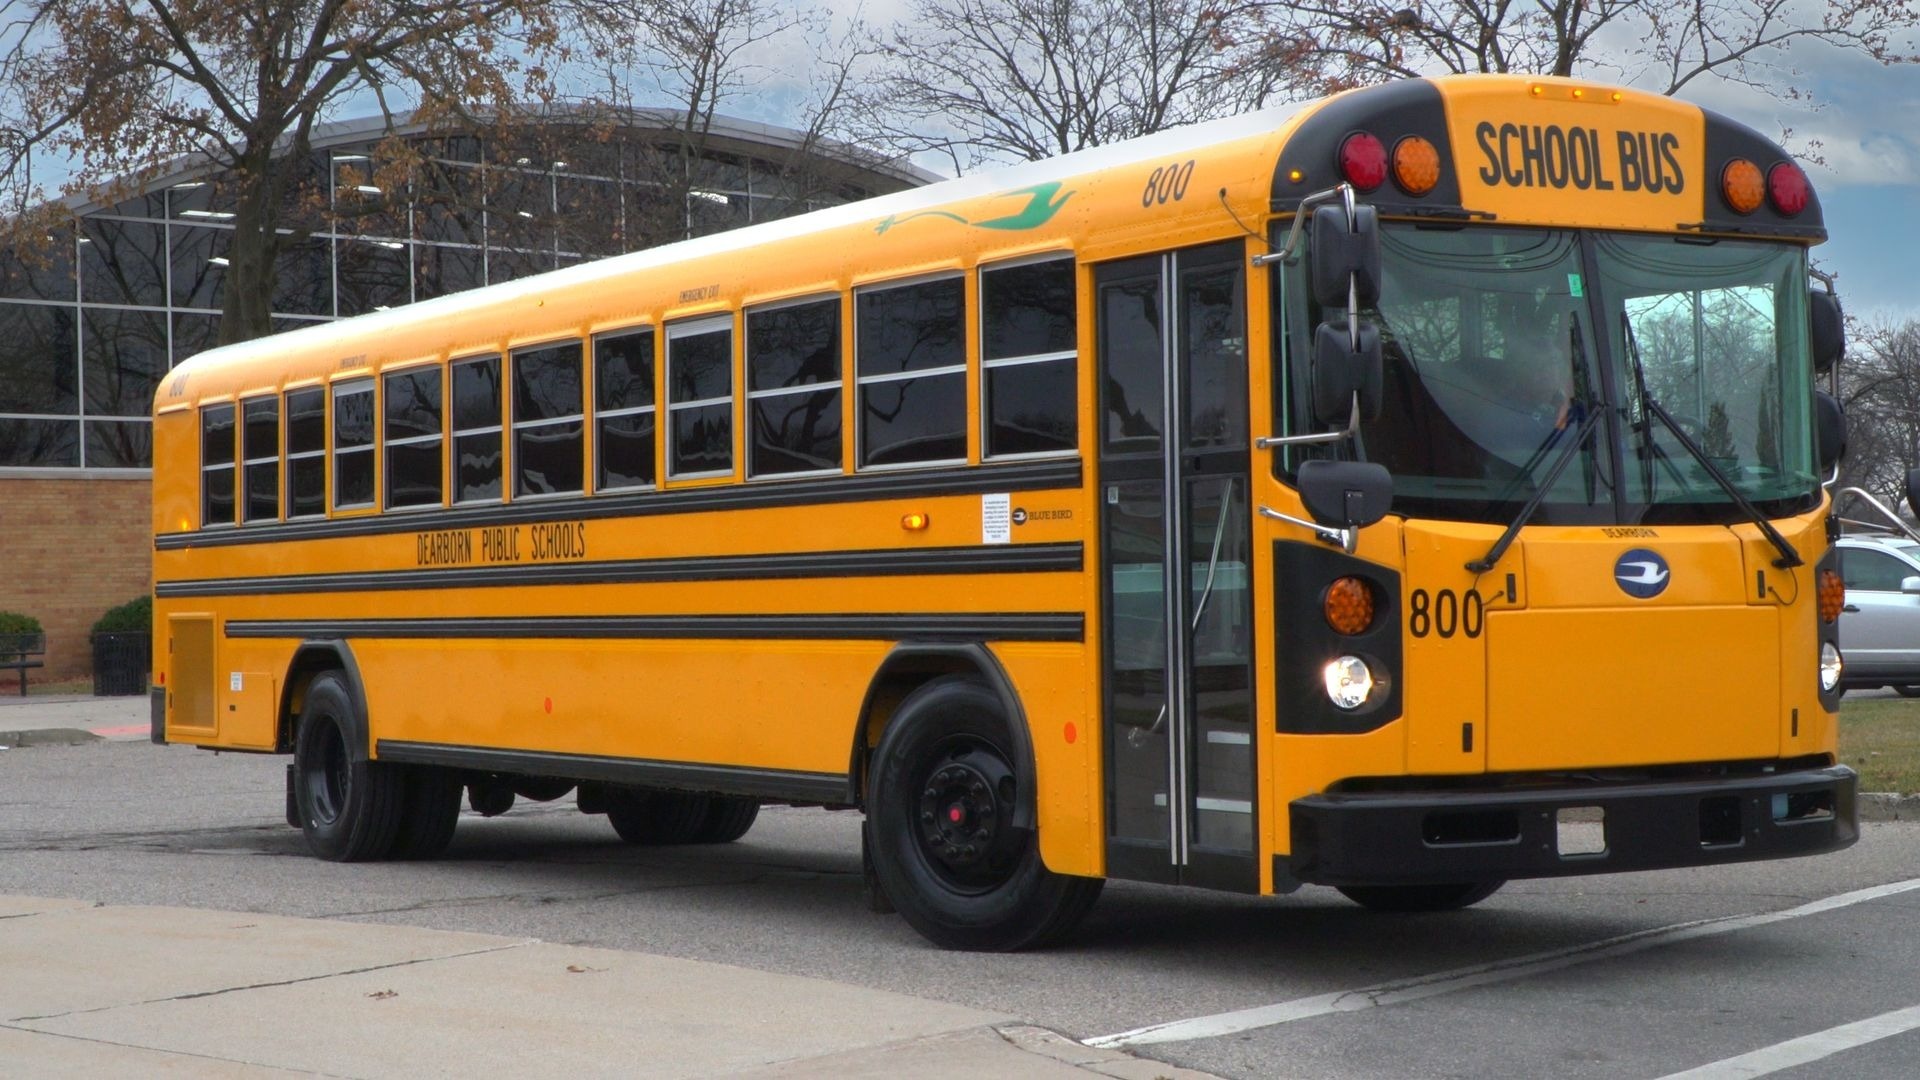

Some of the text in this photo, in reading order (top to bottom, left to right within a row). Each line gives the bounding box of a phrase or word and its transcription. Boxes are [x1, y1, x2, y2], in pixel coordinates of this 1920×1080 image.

[1475, 121, 1684, 195] SCHOOL BUS
[1142, 159, 1195, 208] 800
[1029, 509, 1073, 520] BLUE BIRD
[1601, 528, 1660, 538] DEARBORN
[416, 522, 585, 565] DEARBORN PUBLIC SCHOOLS
[1409, 588, 1483, 639] 800
